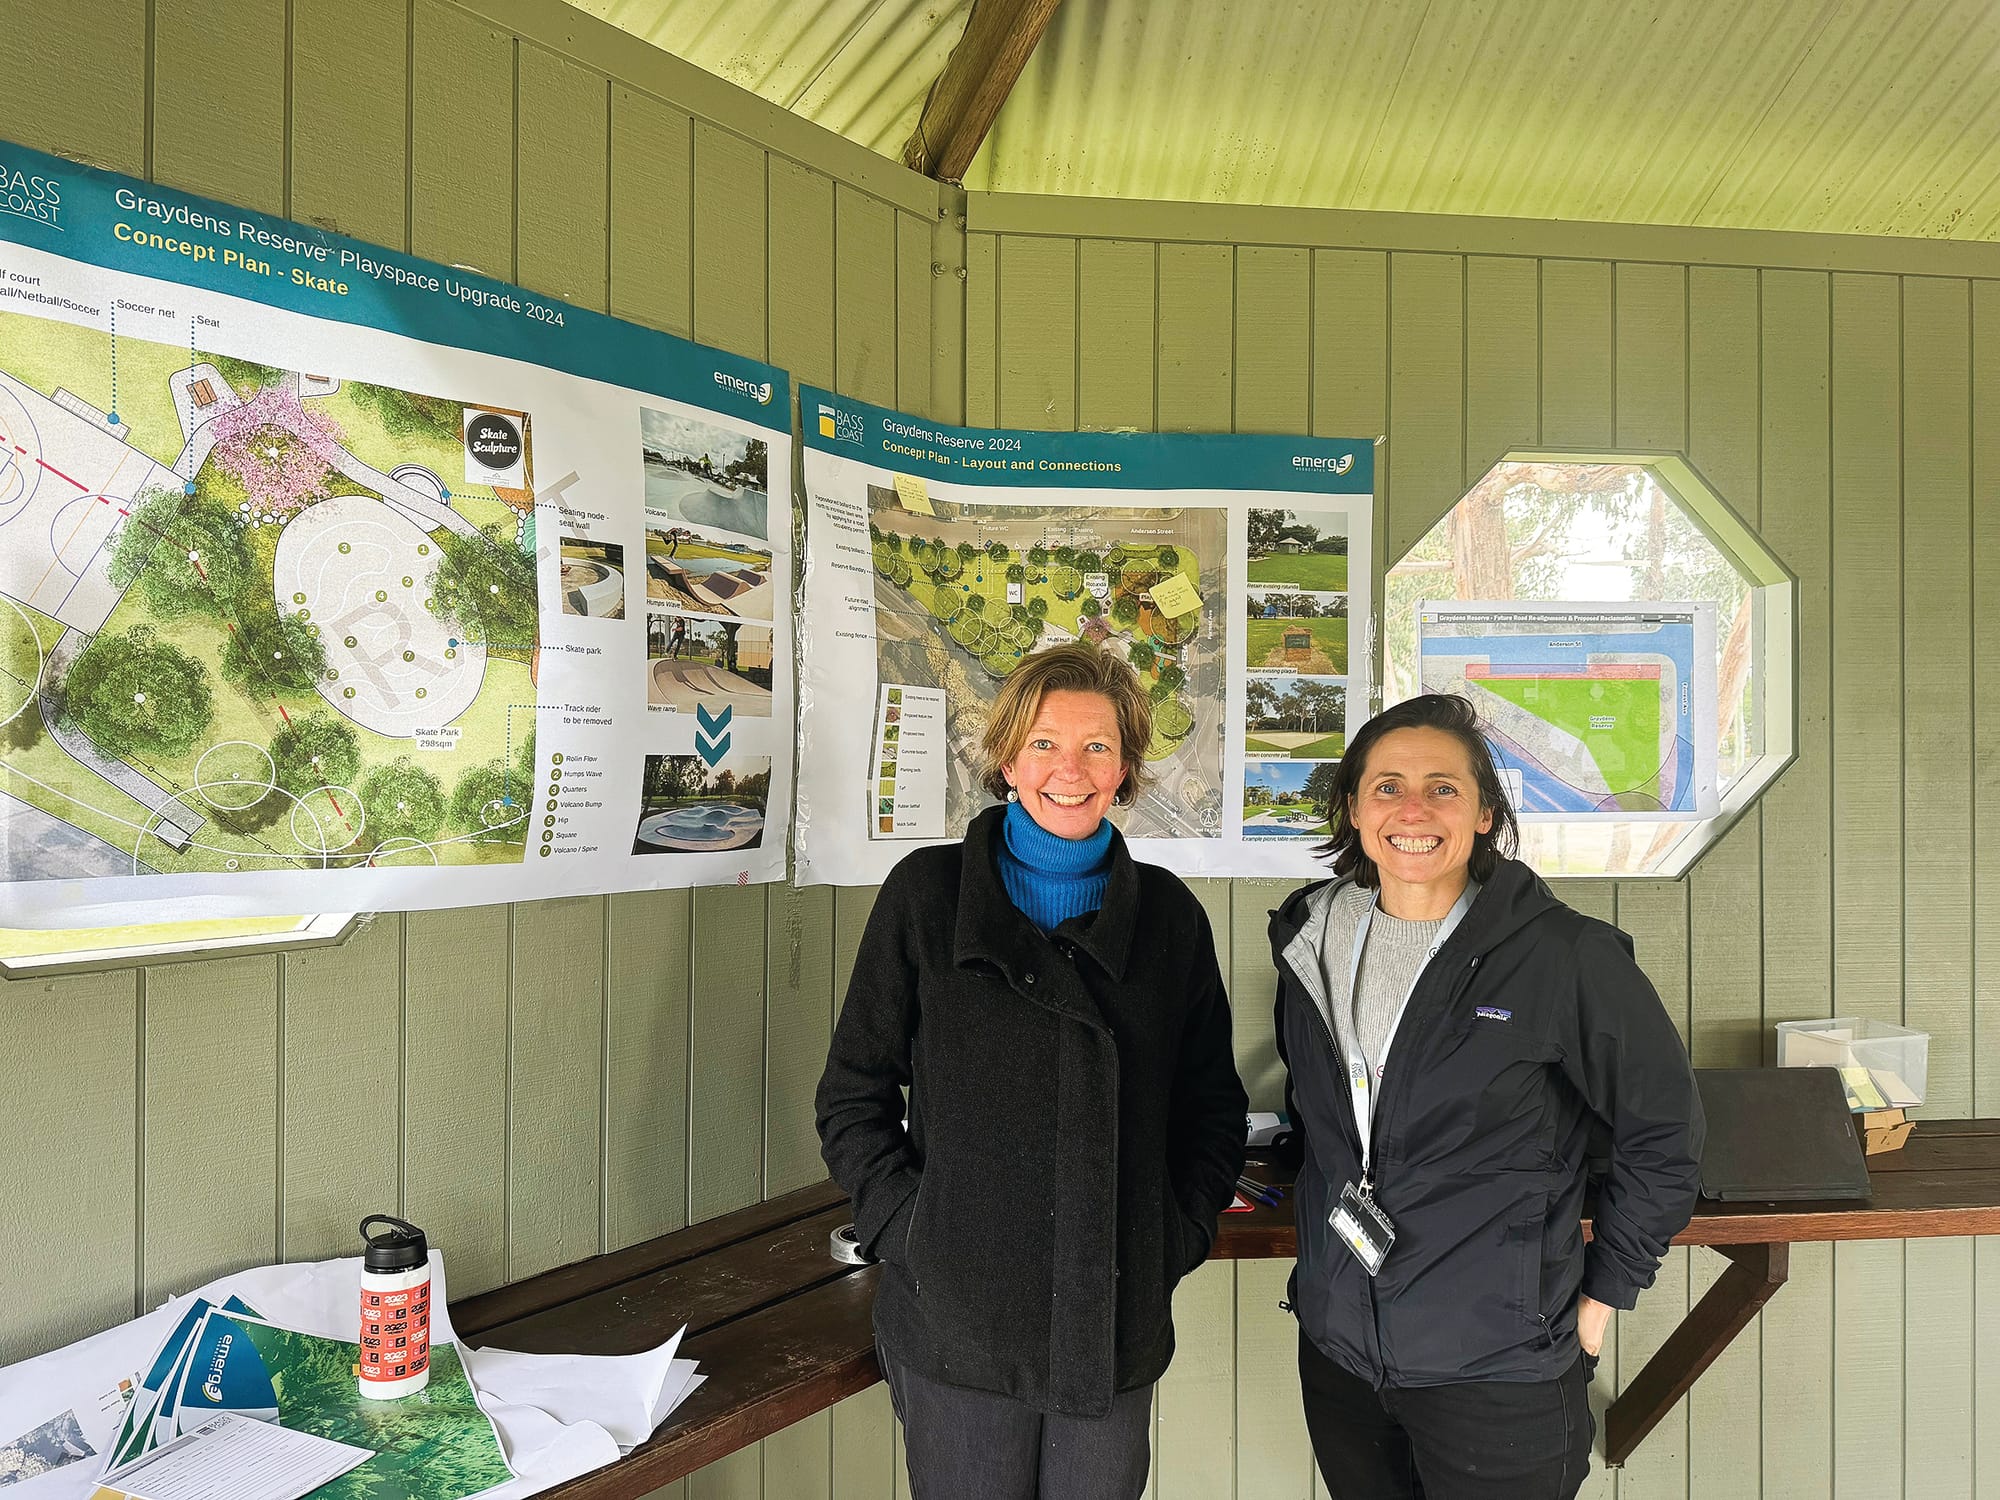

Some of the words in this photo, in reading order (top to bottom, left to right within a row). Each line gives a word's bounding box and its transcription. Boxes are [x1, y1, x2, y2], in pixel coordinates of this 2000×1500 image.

[113, 221, 216, 263] Concept
[222, 248, 272, 277] Plan
[290, 267, 349, 296] Skate
[115, 188, 232, 236] Graydens
[238, 221, 328, 262] Reserve
[340, 249, 440, 293] Playspace
[445, 279, 522, 314] Upgrade
[525, 301, 565, 328] 2024
[9, 272, 41, 287] court
[116, 298, 155, 315] Soccer
[158, 309, 176, 319] net
[196, 314, 221, 328] Seat
[713, 371, 771, 402] emerge
[836, 409, 864, 432] BASS
[480, 427, 508, 441] Skate
[836, 426, 864, 442] COAST
[882, 418, 933, 441] Graydens
[935, 431, 985, 450] Reserve
[988, 438, 1022, 451] 2024
[472, 441, 518, 455] Sculpture
[882, 439, 926, 460] Concept
[928, 450, 950, 465] Plan
[962, 456, 1007, 471] Layout
[1010, 459, 1035, 471] and
[1038, 460, 1122, 472] Connections
[1292, 453, 1353, 474] emerge
[558, 506, 586, 520] Seating
[587, 512, 605, 521] node
[645, 507, 667, 518] Volcano
[558, 520, 574, 529] seat
[575, 521, 591, 531] wall
[665, 601, 681, 609] Wave
[565, 644, 585, 653] Skate
[586, 647, 602, 656] park
[564, 704, 585, 713] Track
[585, 704, 602, 714] rider
[647, 704, 662, 712] Wave
[563, 716, 571, 724] to
[572, 716, 582, 725] be
[583, 717, 613, 726] removed
[415, 728, 439, 737] Skate
[440, 728, 460, 737] Park
[420, 739, 453, 748] 298sqm
[562, 786, 588, 794] Quarters
[584, 801, 603, 809] Bump
[555, 832, 577, 840] Square
[553, 846, 578, 854] Volcano
[582, 845, 598, 853] Spine
[383, 1321, 408, 1332] 2023
[203, 1334, 233, 1402] emerge
